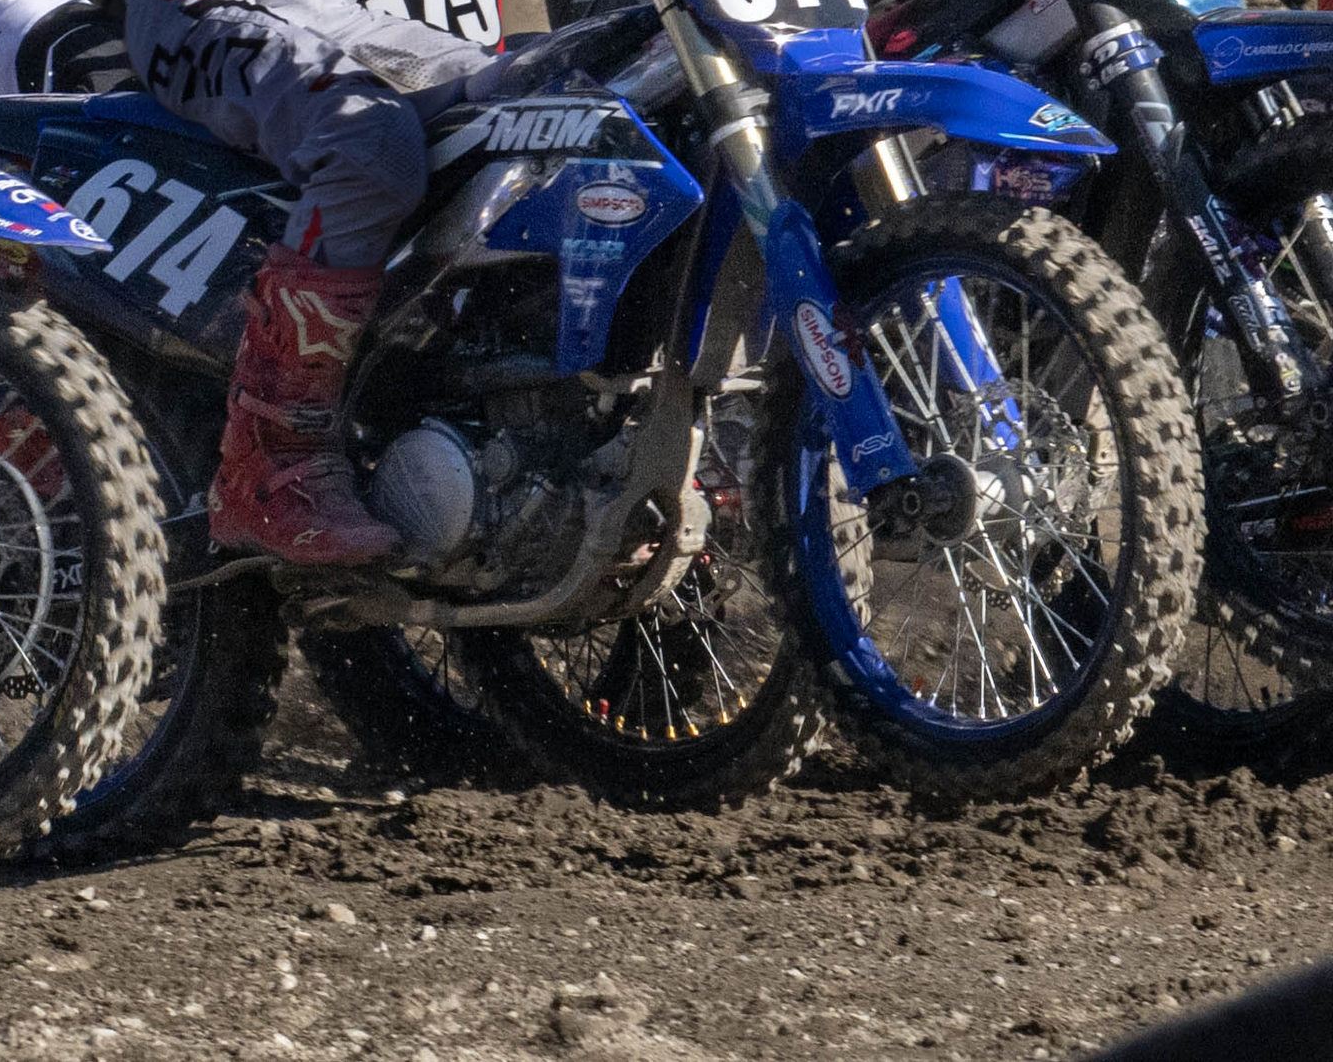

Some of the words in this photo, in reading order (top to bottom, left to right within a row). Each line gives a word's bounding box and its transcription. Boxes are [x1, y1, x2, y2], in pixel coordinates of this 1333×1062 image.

[831, 88, 903, 119] FXR
[65, 158, 249, 317] 674
[798, 303, 847, 393] SIMPSON
